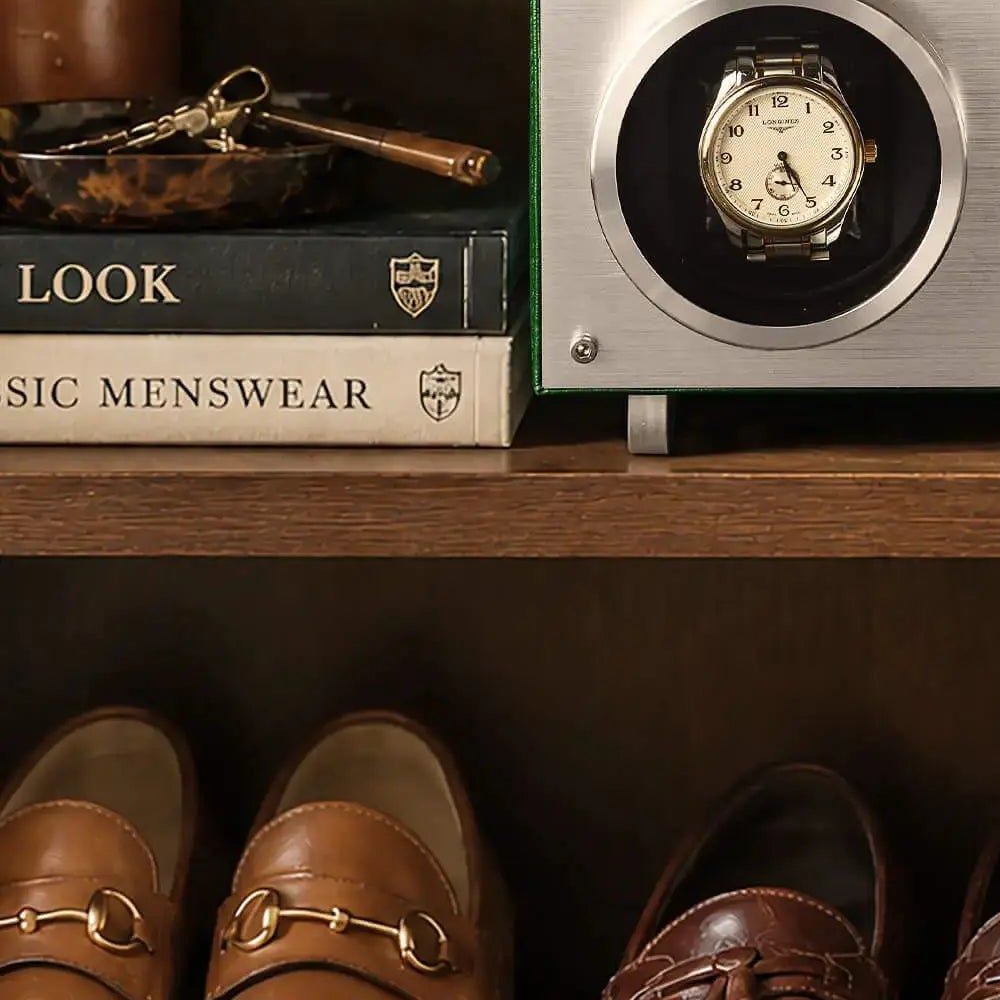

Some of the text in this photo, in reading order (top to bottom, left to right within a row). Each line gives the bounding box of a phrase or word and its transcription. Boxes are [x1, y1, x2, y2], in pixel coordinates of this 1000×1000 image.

[772, 95, 789, 108] 12
[748, 105, 760, 117] 11
[805, 102, 811, 114] 1
[728, 125, 744, 137] 10
[822, 121, 835, 134] 2
[721, 152, 732, 165] 9
[831, 148, 844, 160] 3
[730, 179, 742, 191] 8
[821, 174, 836, 187] 4
[751, 198, 764, 210] 7
[805, 196, 817, 208] 5
[778, 204, 790, 216] 6
[17, 264, 181, 303] LOOK
[0, 375, 372, 410] SIC MENSWEAR
